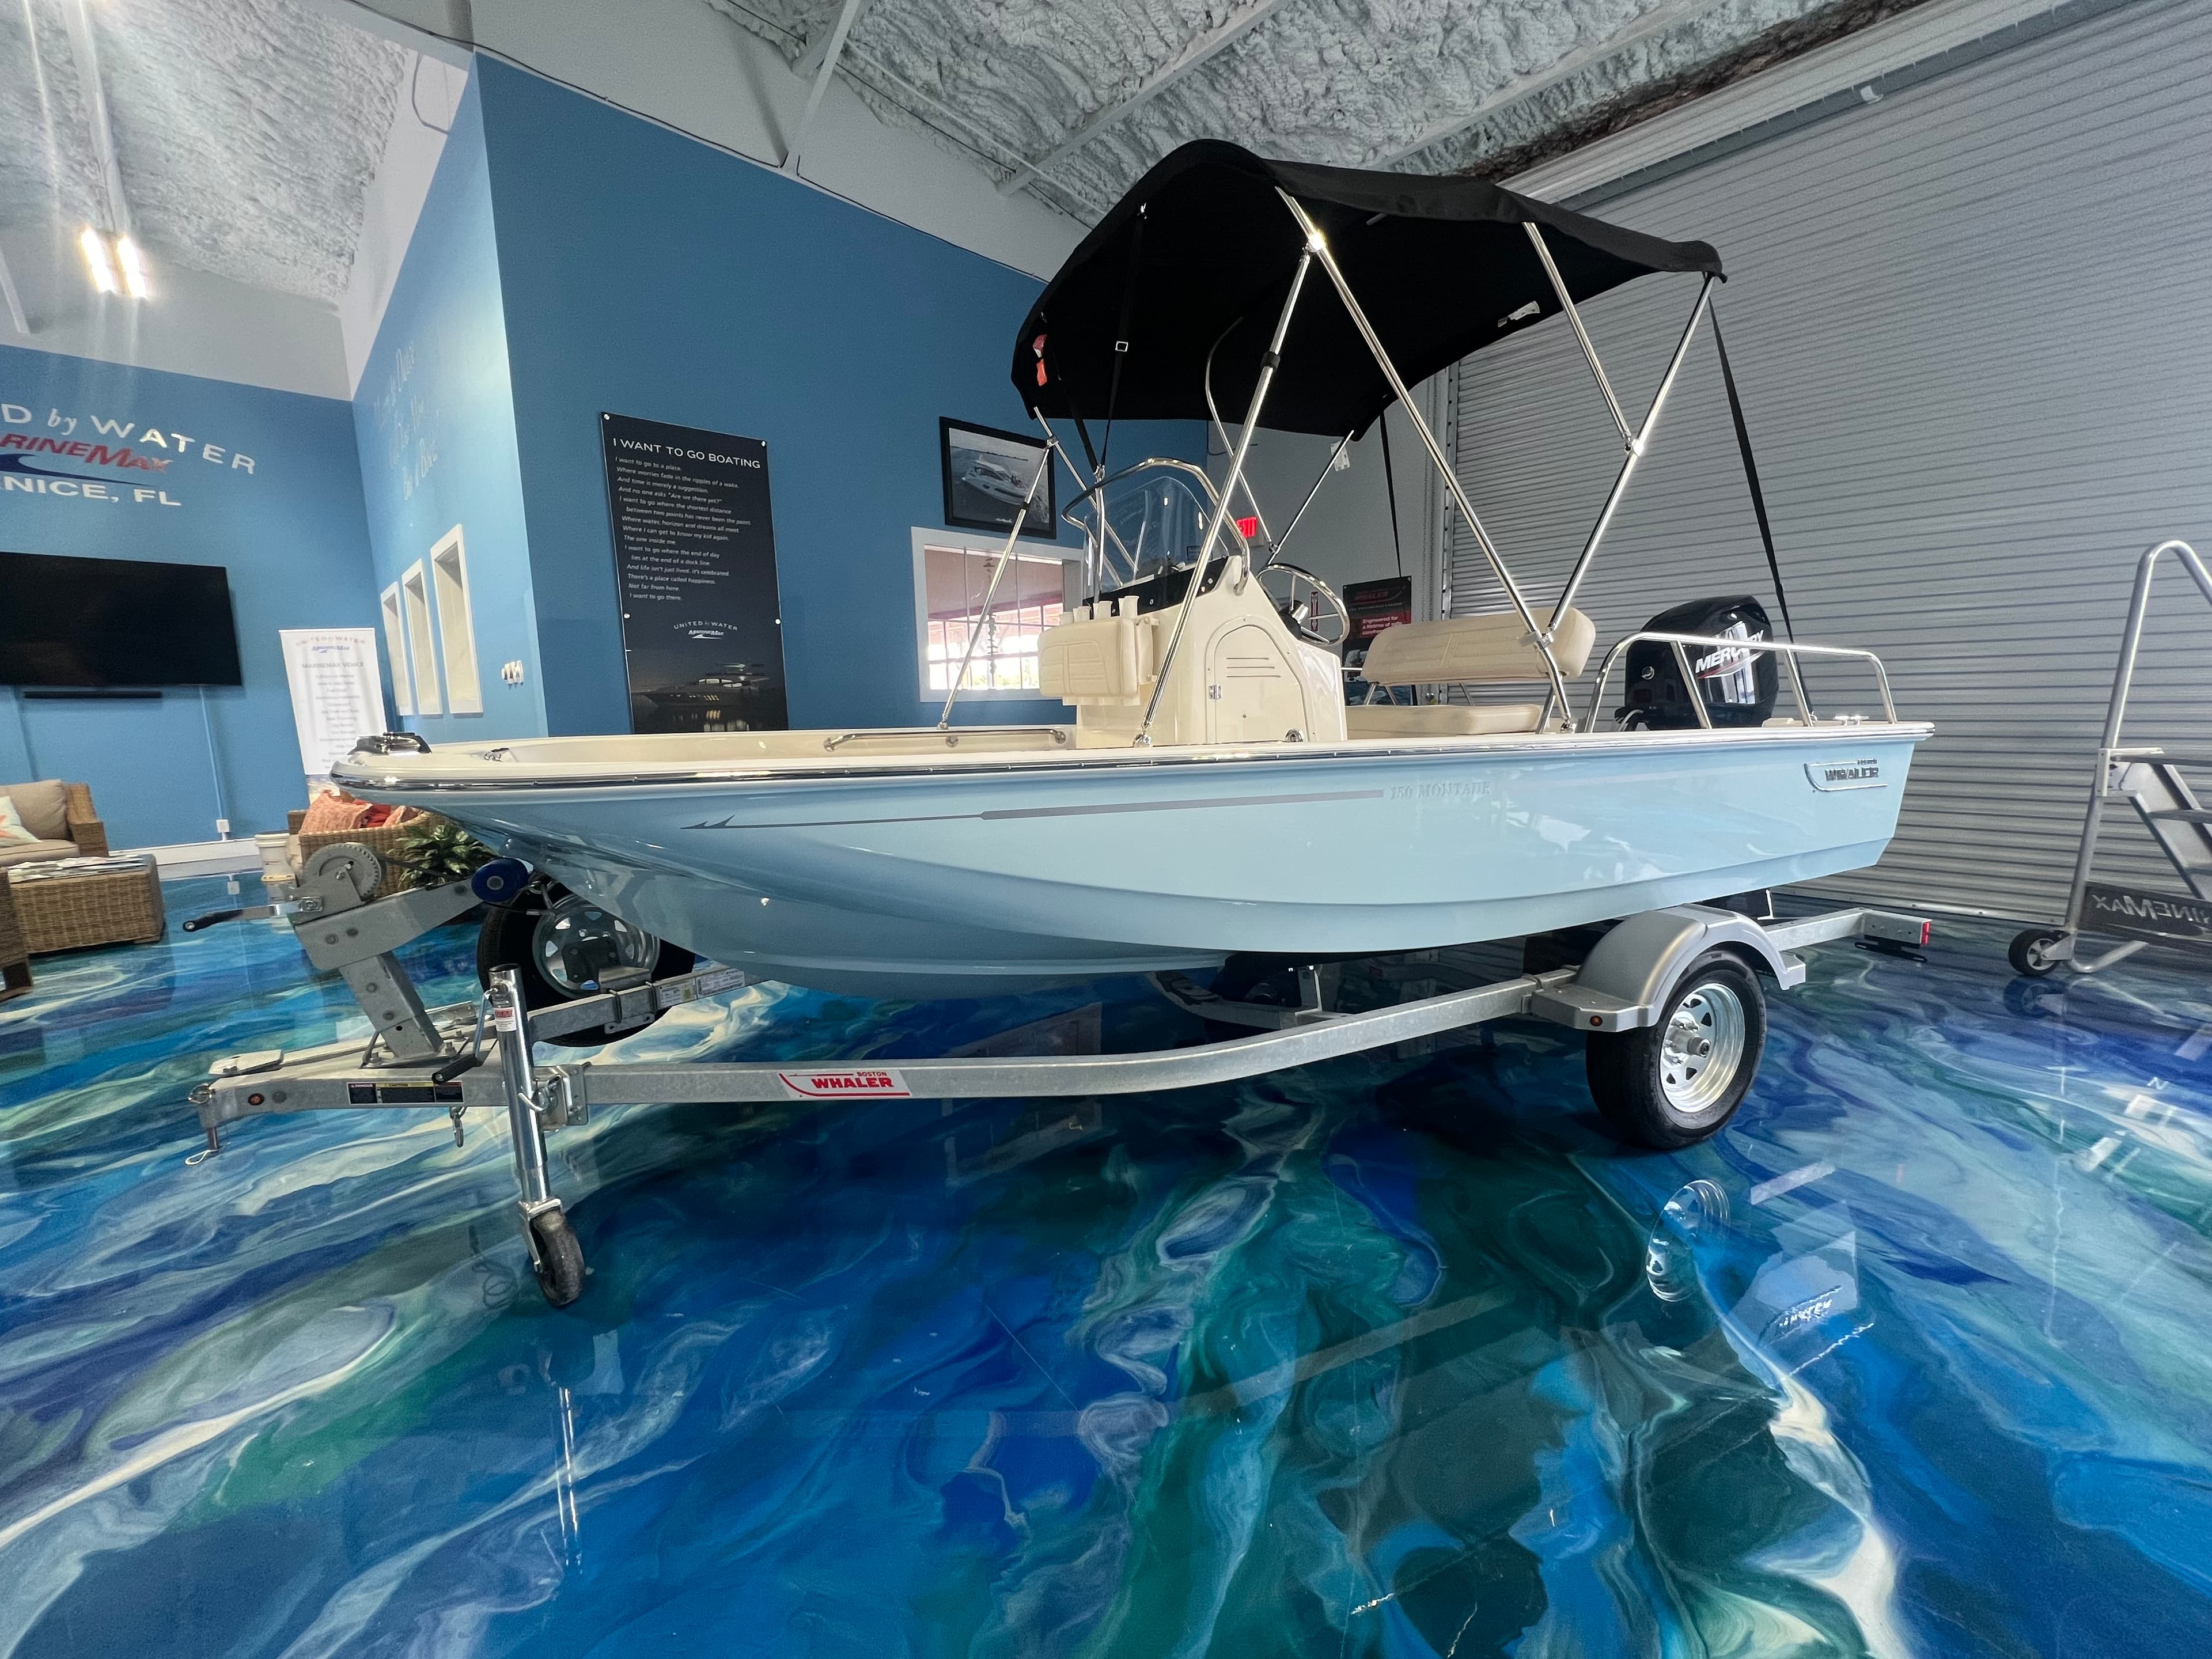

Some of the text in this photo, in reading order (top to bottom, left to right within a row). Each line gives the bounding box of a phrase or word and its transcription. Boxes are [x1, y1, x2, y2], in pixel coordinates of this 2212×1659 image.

[47, 408, 77, 435] by
[90, 415, 255, 474] WATER
[613, 438, 760, 468] I WANT TO GO BOATING
[0, 476, 182, 506] NICE, FL
[652, 482, 672, 490] merely
[673, 620, 703, 630] UNITED
[711, 622, 738, 631] WATER
[1390, 781, 1493, 800] 150 MONTAUK
[811, 1077, 895, 1089] WHALER
